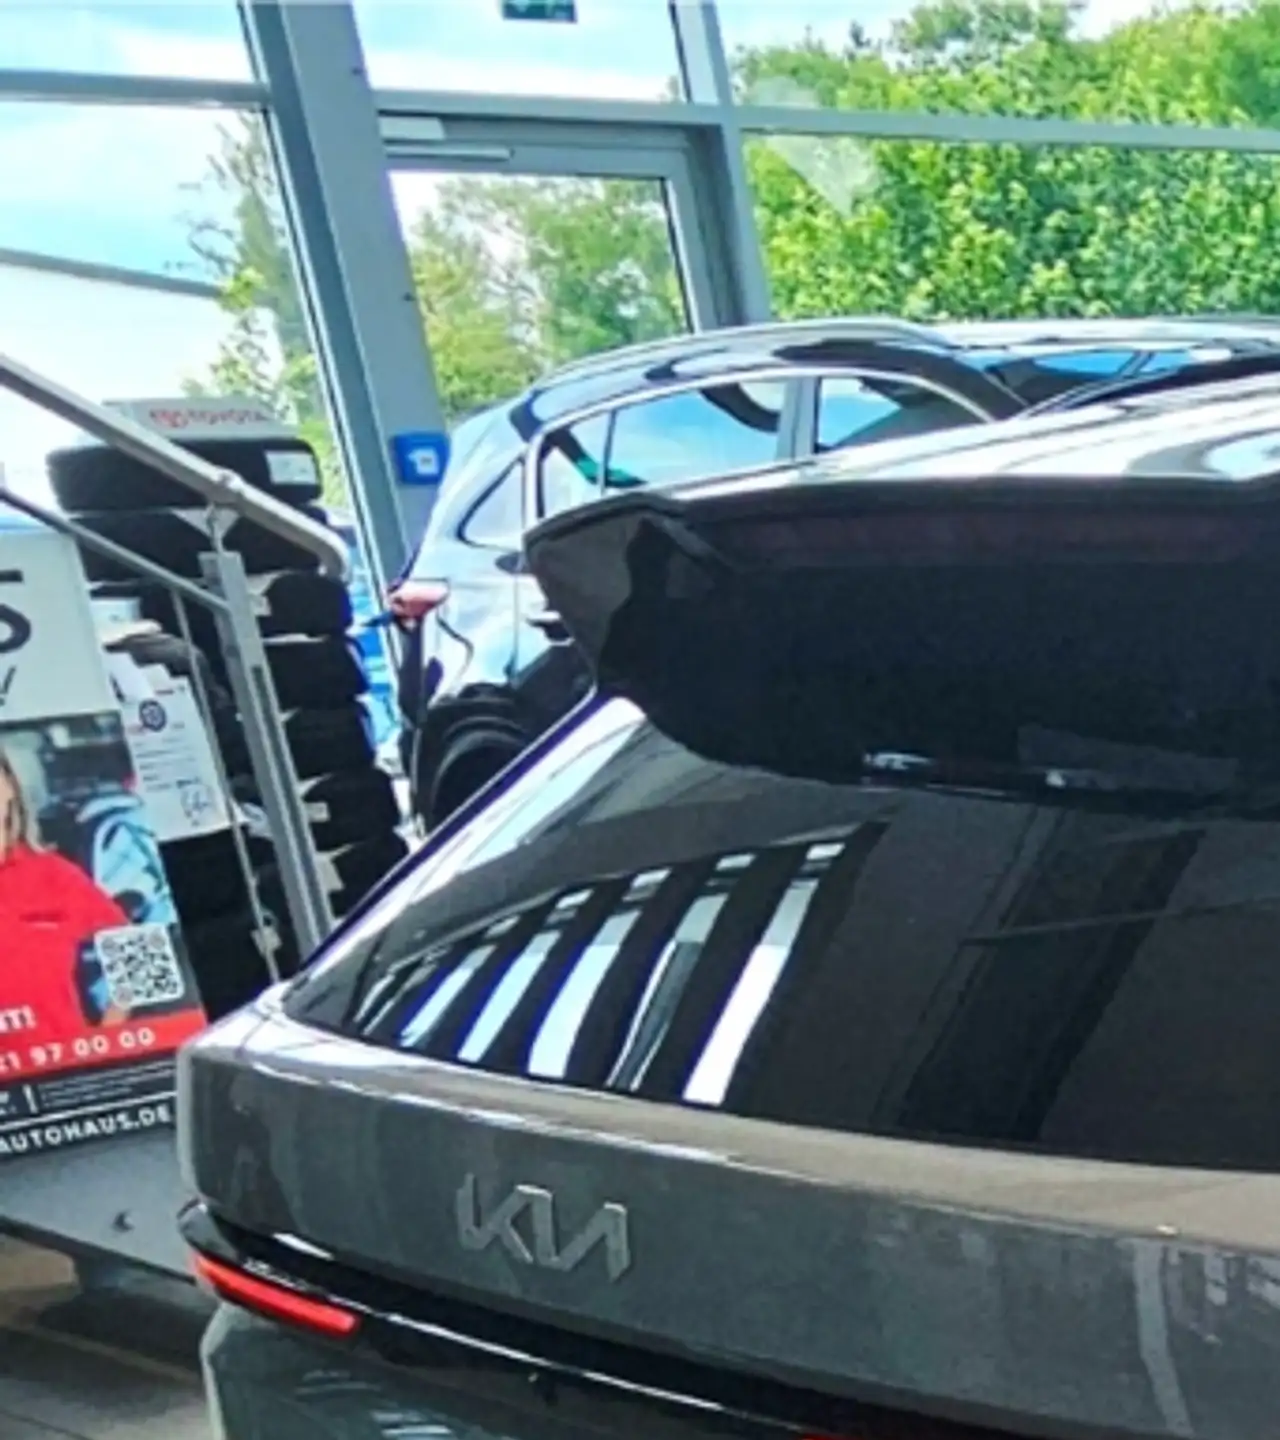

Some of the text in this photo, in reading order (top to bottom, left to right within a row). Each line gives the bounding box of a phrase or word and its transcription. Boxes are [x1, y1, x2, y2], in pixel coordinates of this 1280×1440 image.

[73, 1034, 110, 1059] 00
[118, 1026, 156, 1048] 00
[455, 1172, 632, 1283] KIA
